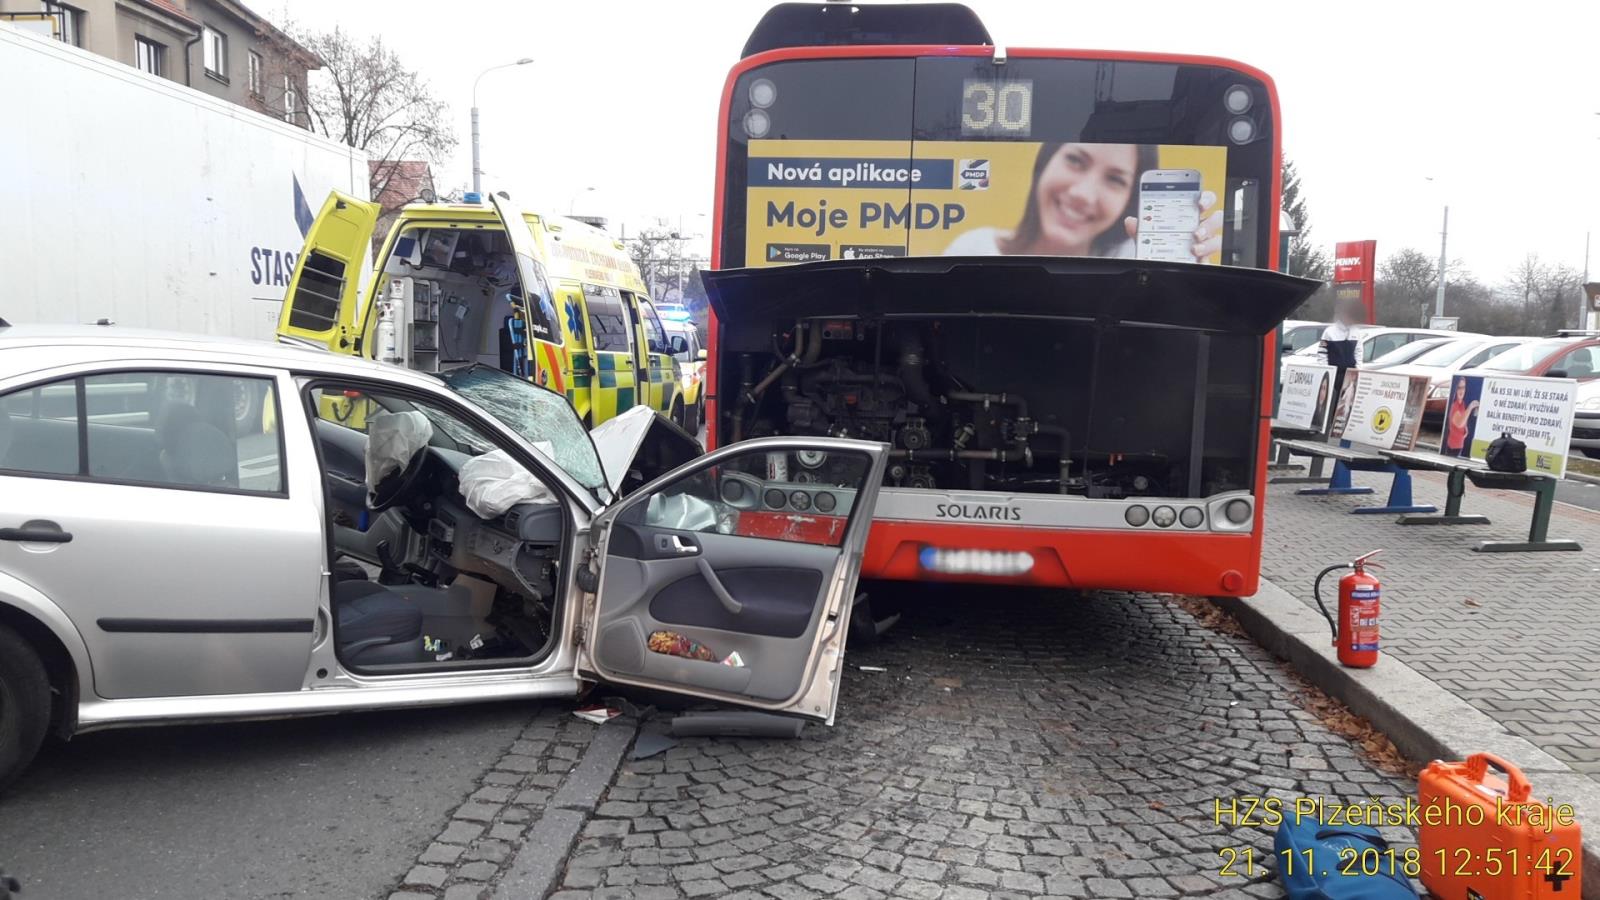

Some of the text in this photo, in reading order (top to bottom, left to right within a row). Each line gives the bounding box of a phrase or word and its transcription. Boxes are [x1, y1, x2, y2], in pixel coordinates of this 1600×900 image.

[963, 83, 1032, 130] 30
[767, 162, 922, 187] Nová aplikace
[766, 199, 966, 237] Moje PMDP
[250, 246, 301, 288] STAS
[784, 252, 827, 261] Google Play
[1549, 391, 1569, 401] STARÁ
[1527, 415, 1540, 426] PRO
[935, 504, 1021, 521] SOLARIS
